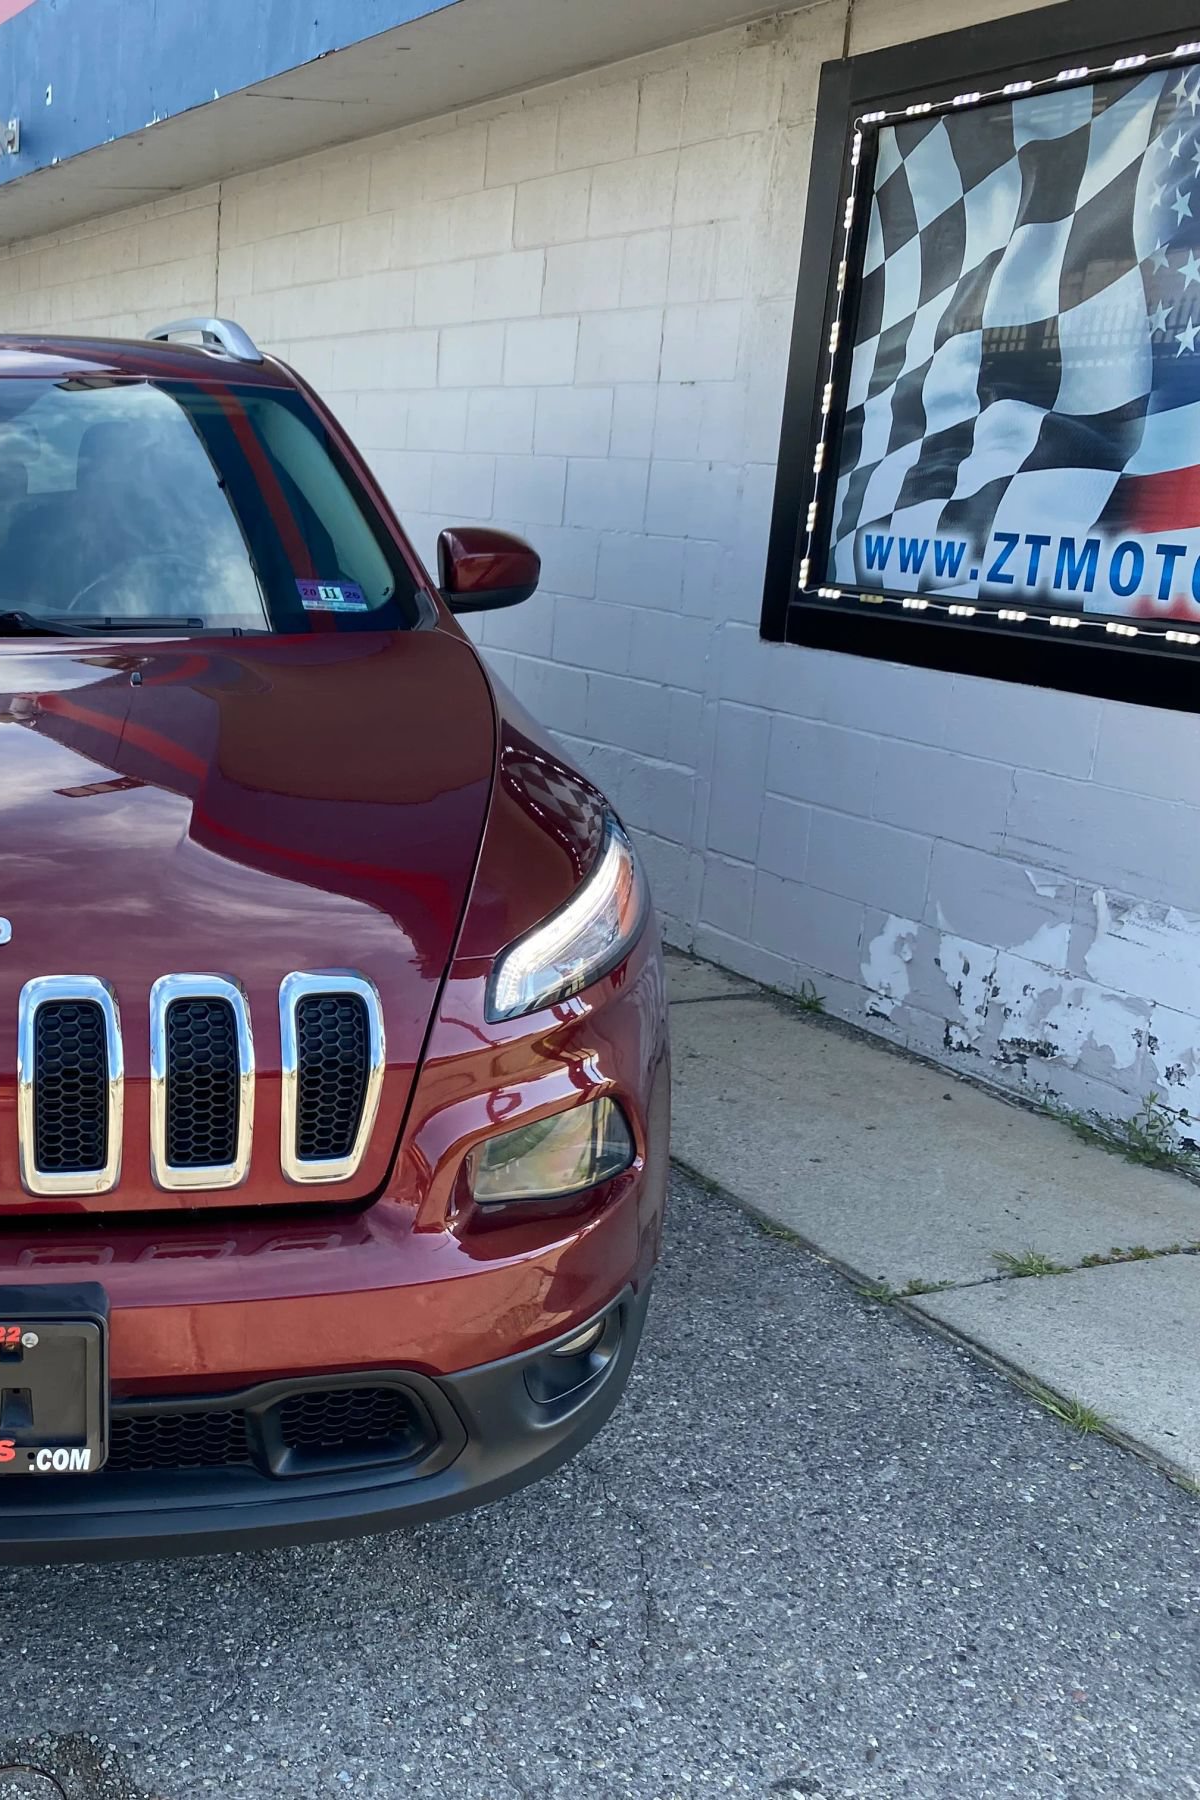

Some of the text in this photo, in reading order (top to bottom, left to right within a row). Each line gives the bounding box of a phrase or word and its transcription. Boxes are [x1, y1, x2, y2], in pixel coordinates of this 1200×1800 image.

[865, 531, 1200, 604] www.ZTMOT
[322, 588, 339, 599] 11
[29, 1449, 91, 1471] .COM
